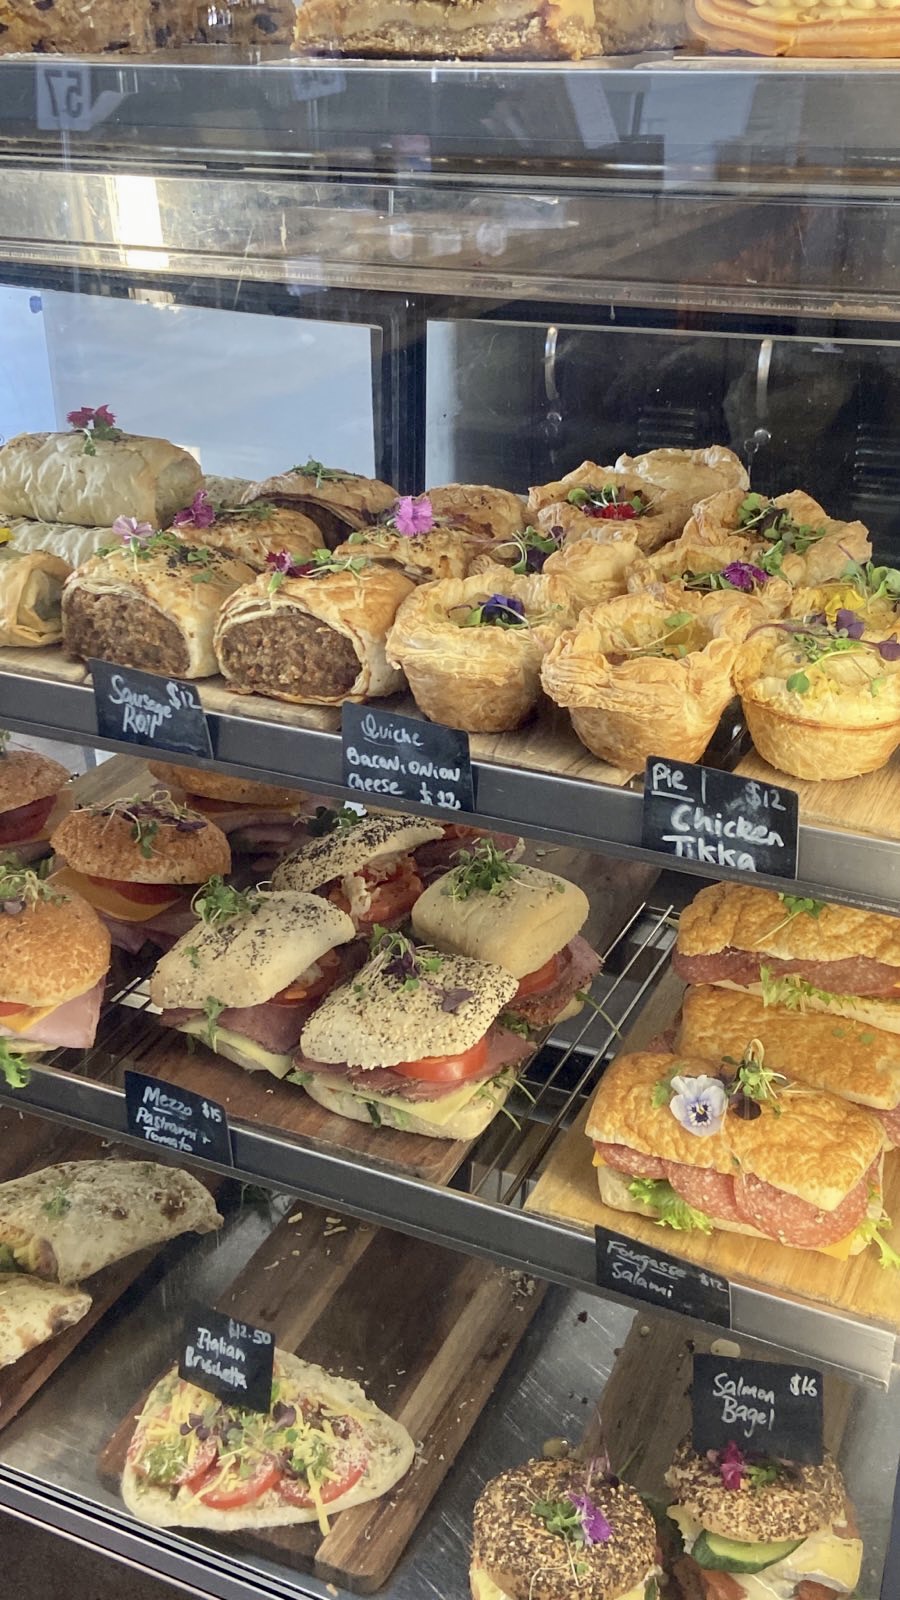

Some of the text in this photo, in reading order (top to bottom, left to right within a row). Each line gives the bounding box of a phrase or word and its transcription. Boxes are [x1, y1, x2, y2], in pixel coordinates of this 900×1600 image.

[166, 681, 203, 710] $12
[361, 713, 424, 746] Quiche
[652, 762, 688, 790] Pie
[745, 780, 787, 811] $12
[670, 803, 785, 848] Chicken
[661, 835, 757, 873] Tikka
[142, 1086, 222, 1123] Mezzo $15
[611, 1262, 674, 1299] Salami
[712, 1372, 818, 1405] Salmon $16
[720, 1394, 775, 1438] Bagel
